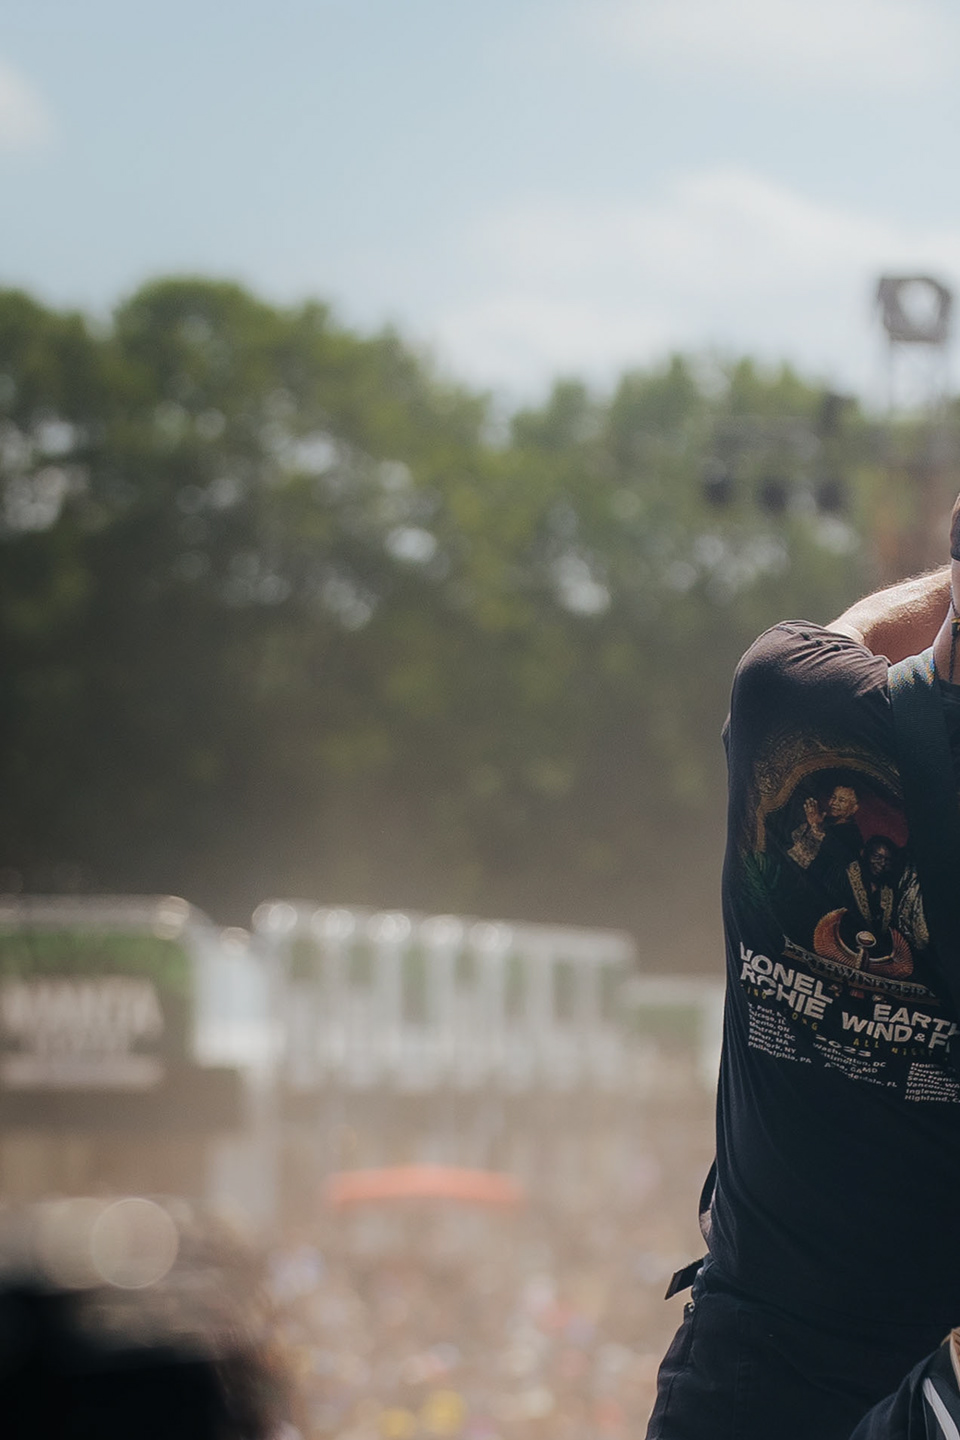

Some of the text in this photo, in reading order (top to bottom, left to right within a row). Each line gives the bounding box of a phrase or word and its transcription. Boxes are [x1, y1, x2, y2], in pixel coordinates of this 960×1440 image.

[740, 962, 828, 1020] RCHIE
[841, 1011, 913, 1042] WIND
[853, 1038, 879, 1049] ALL
